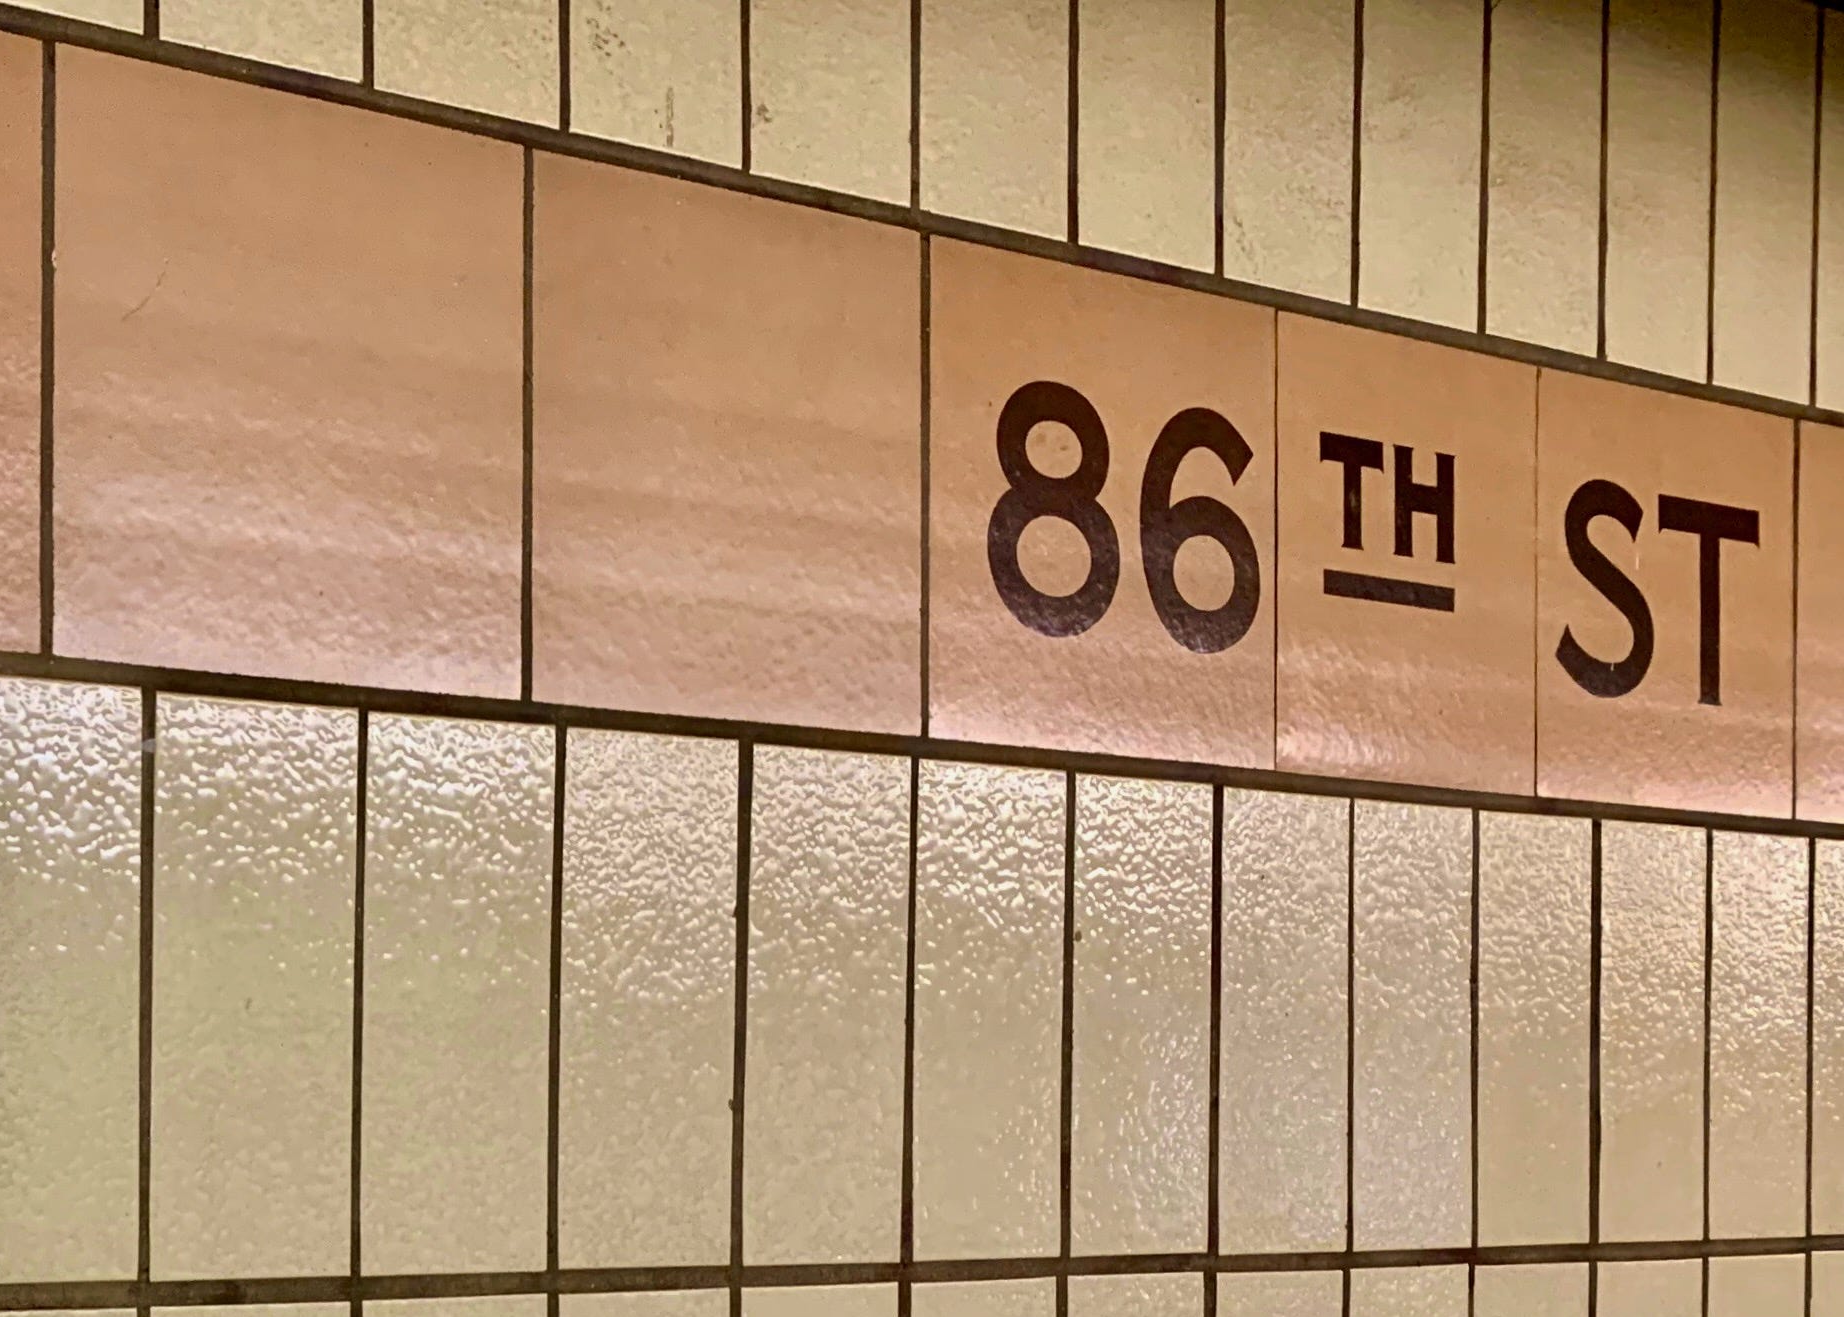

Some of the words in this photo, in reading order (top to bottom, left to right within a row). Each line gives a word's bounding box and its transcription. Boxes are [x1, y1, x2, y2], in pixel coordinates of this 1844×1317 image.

[987, 379, 1261, 655] 86
[1319, 431, 1456, 564] TH
[1555, 477, 1761, 706] ST
